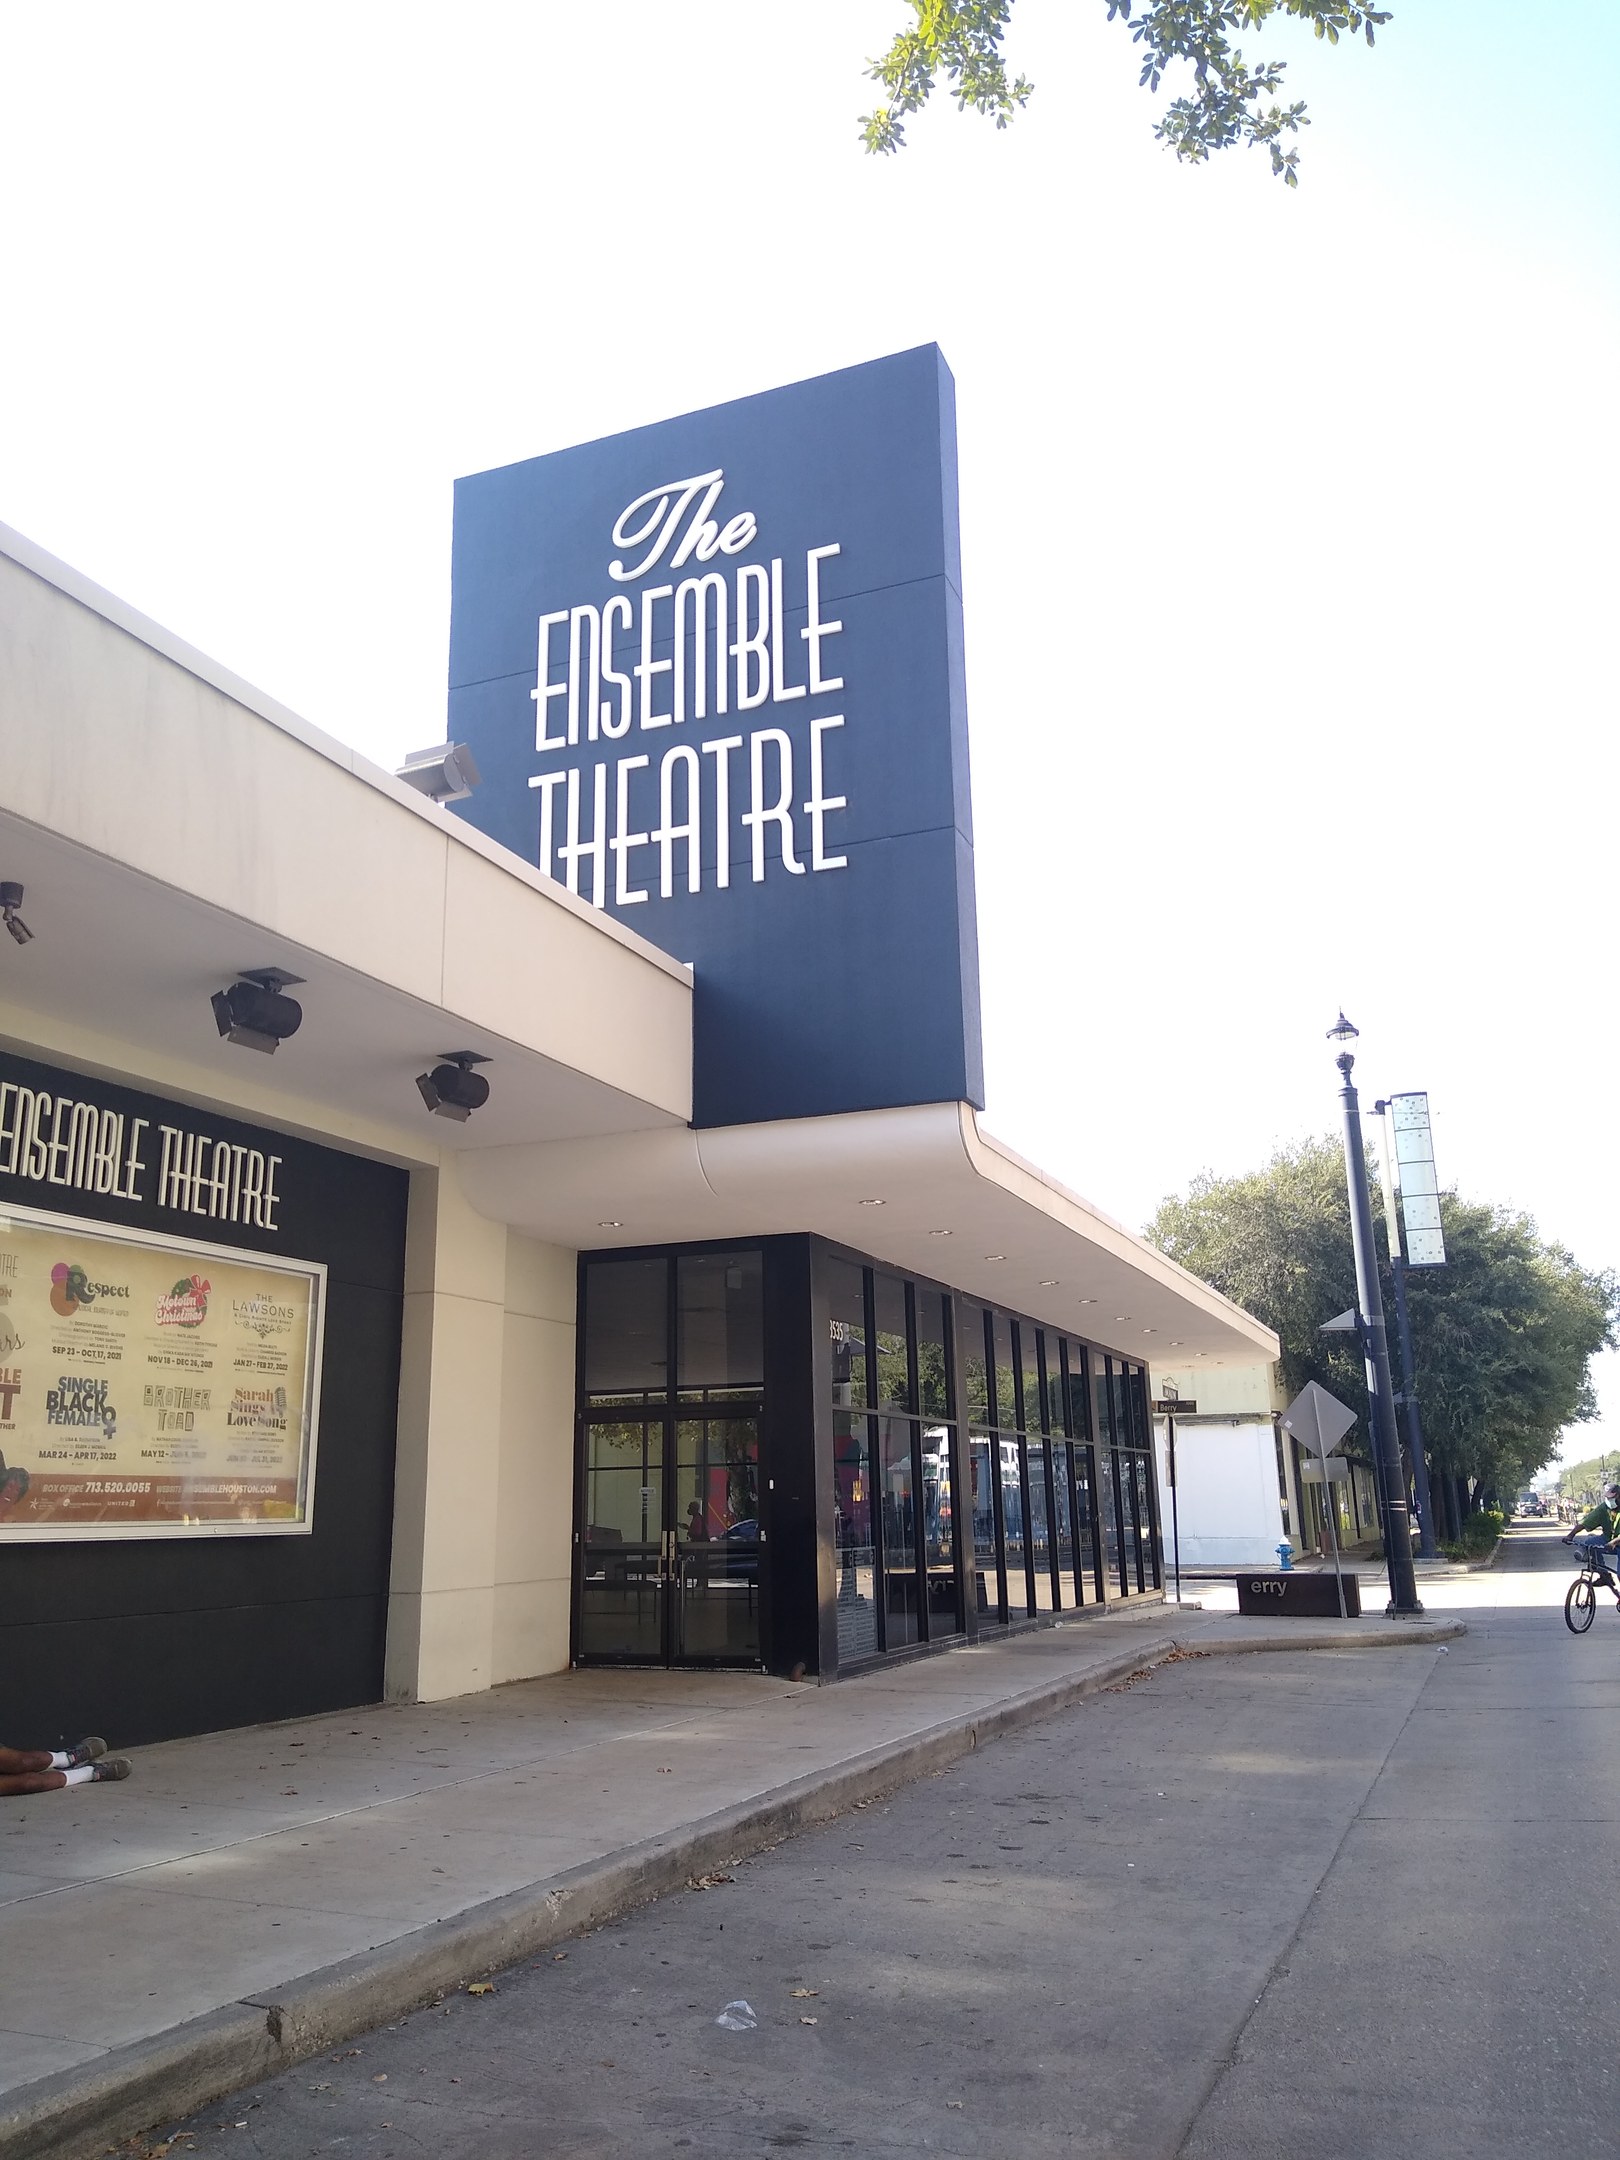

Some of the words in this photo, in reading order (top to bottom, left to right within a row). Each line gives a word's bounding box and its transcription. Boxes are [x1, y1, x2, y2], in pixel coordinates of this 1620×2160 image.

[608, 468, 758, 582] The
[530, 542, 845, 752] ENSEMBLE
[528, 714, 849, 910] THEATRE
[0, 1082, 149, 1201] ENSEMBLE
[157, 1124, 282, 1231] THEATRE
[0, 1252, 19, 1278] TRE
[65, 1269, 130, 1304] Respect
[157, 1294, 197, 1311] Motown
[255, 1293, 273, 1303] THE
[155, 1309, 203, 1325] Christmas
[232, 1299, 295, 1319] LAWSONS
[52, 1346, 66, 1354] SEP
[67, 1346, 75, 1355] 23
[147, 1355, 163, 1363] NOV
[176, 1358, 190, 1366] DEC
[233, 1359, 246, 1367] JAN
[256, 1361, 267, 1369] FEB
[58, 1376, 108, 1395] SINGLE
[46, 1390, 108, 1413] BLACK
[143, 1385, 211, 1411] BROTHER
[234, 1387, 274, 1402] Sarah
[230, 1399, 265, 1414] Sings
[1160, 1404, 1178, 1413] Berry
[47, 1409, 101, 1427] FEMALE
[158, 1409, 194, 1431] TOAD
[58, 1451, 67, 1459] 24
[74, 1452, 90, 1460] APR
[90, 1452, 99, 1461] 17,
[100, 1452, 117, 1460] 2022
[42, 1484, 60, 1492] BOX
[60, 1484, 84, 1493] OFFICE
[85, 1482, 151, 1493] 713.520.0055
[1250, 1580, 1288, 1597] erry
